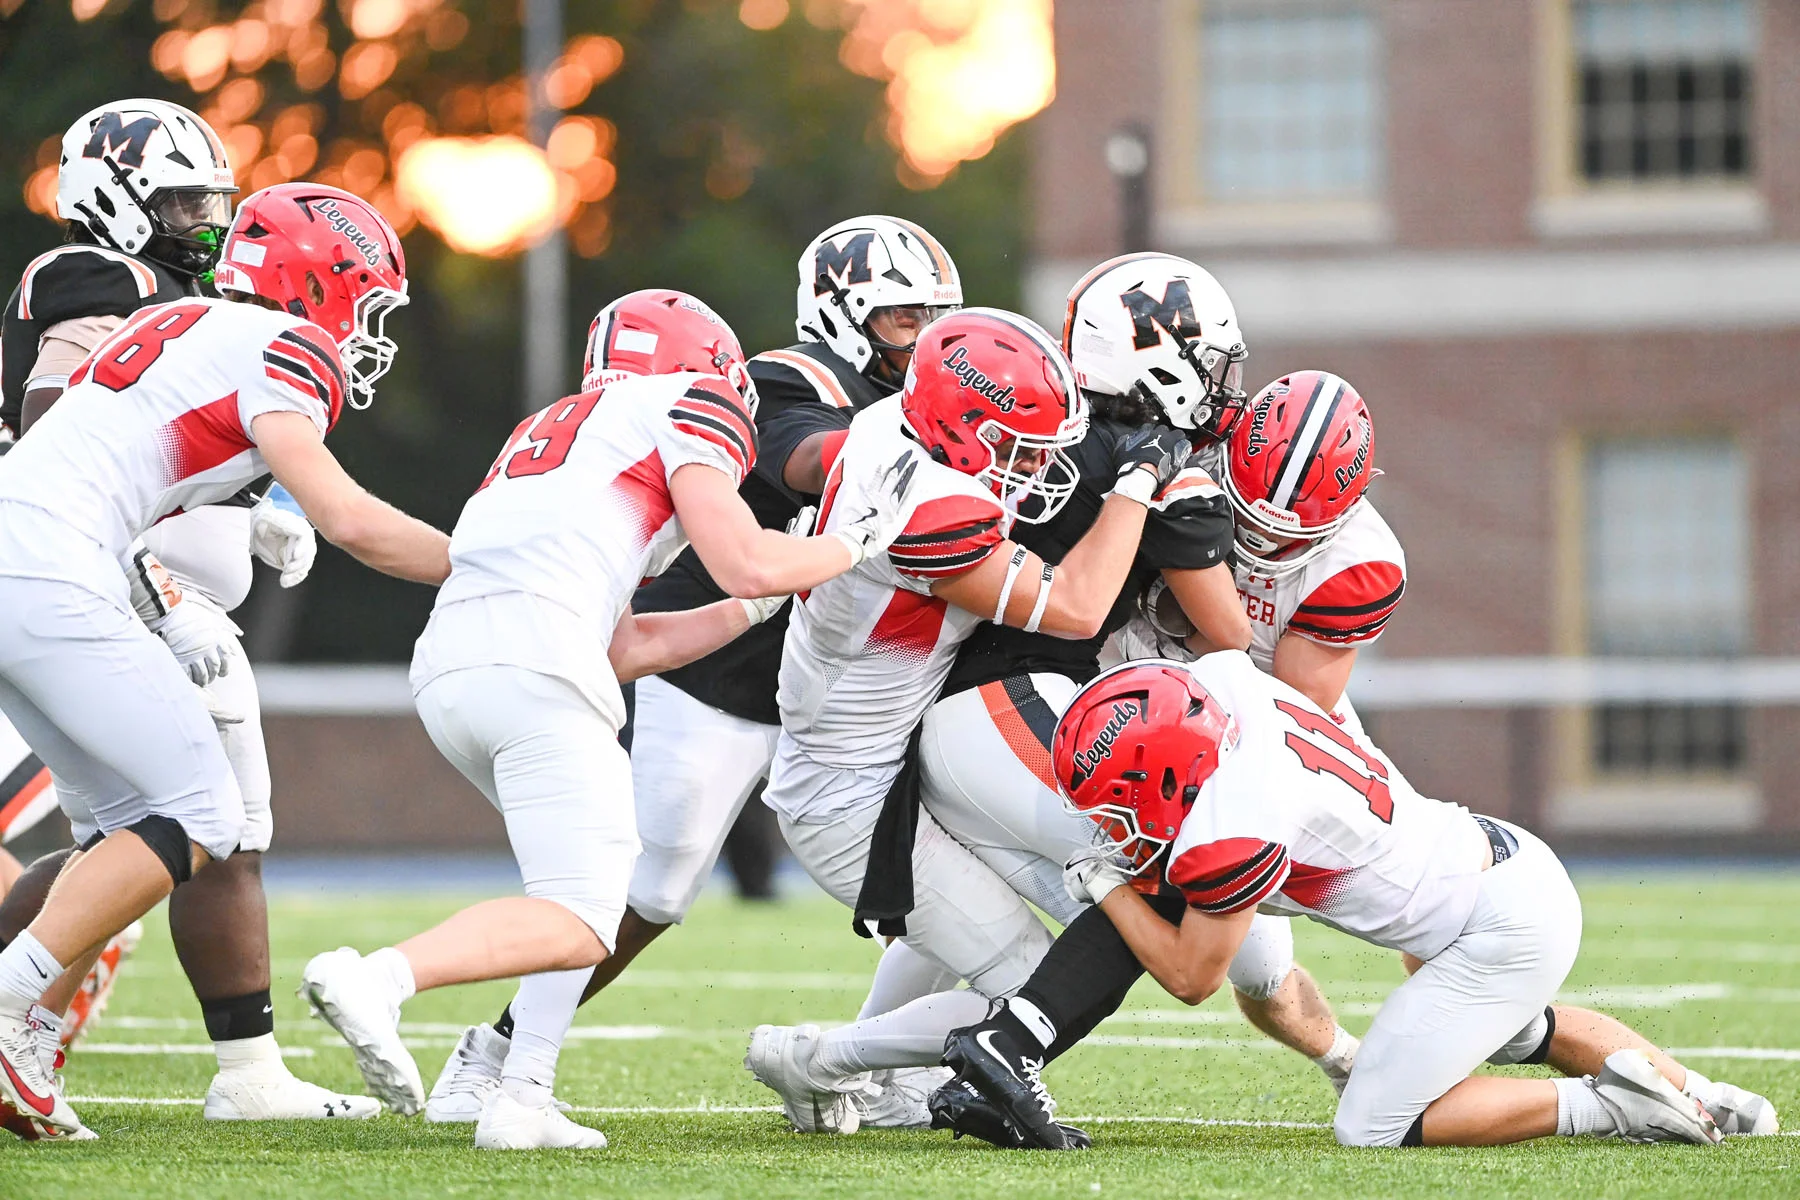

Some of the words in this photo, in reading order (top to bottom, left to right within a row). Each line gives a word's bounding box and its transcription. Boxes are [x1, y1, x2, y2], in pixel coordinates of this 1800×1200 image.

[82, 112, 162, 169] M
[312, 199, 382, 267] Legends
[813, 232, 876, 298] M
[1119, 279, 1202, 351] M
[943, 346, 1017, 413] Legends
[1247, 386, 1290, 457] Legends
[1258, 503, 1295, 522] Riddell
[1074, 700, 1139, 779] Legends
[1273, 698, 1394, 825] 11
